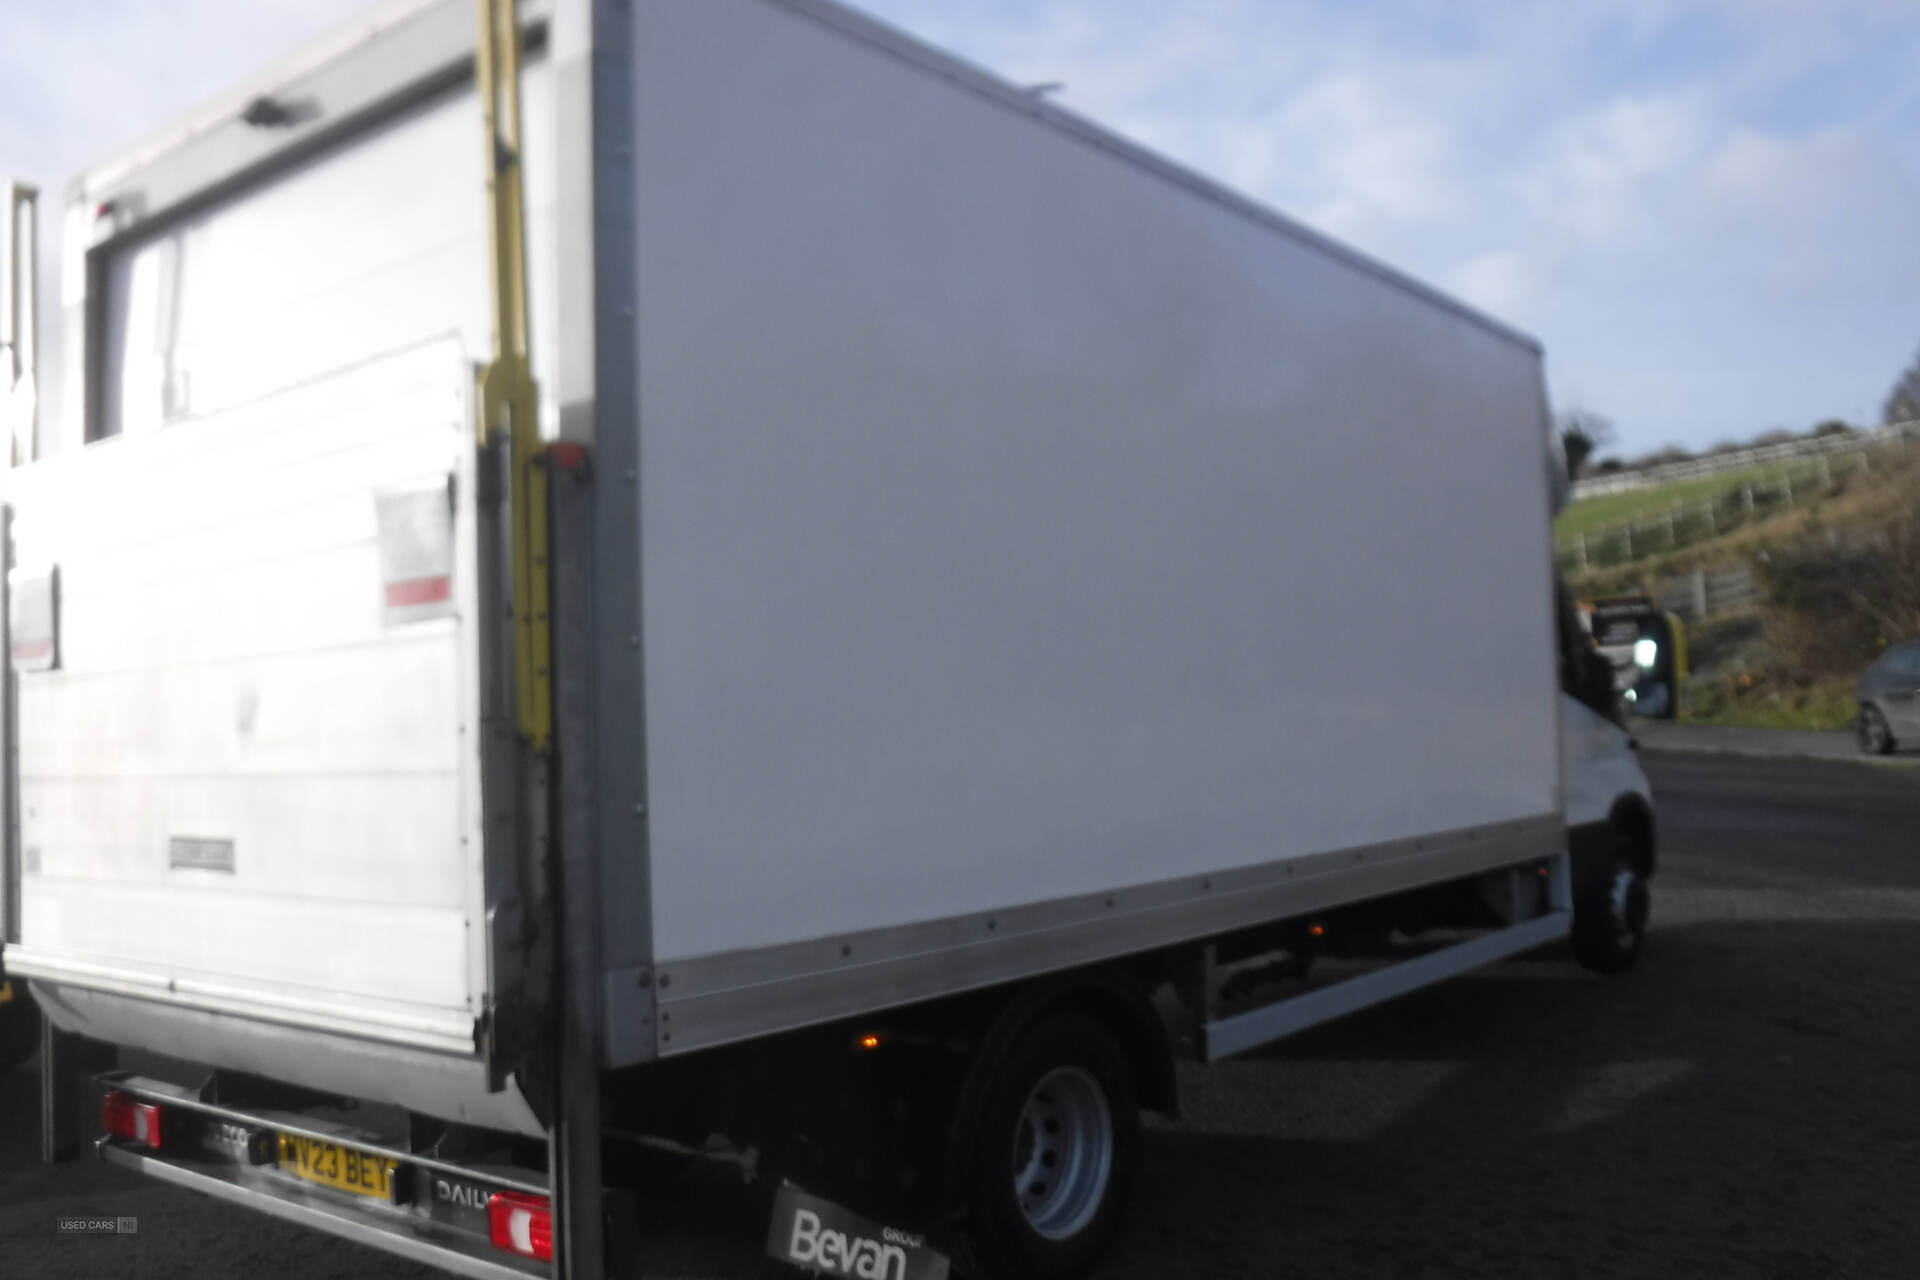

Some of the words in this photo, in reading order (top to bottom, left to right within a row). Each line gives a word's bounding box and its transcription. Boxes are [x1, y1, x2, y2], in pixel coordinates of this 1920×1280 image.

[286, 1137, 339, 1178] V23
[344, 1147, 389, 1191] BEY
[789, 1208, 906, 1280] Bevan
